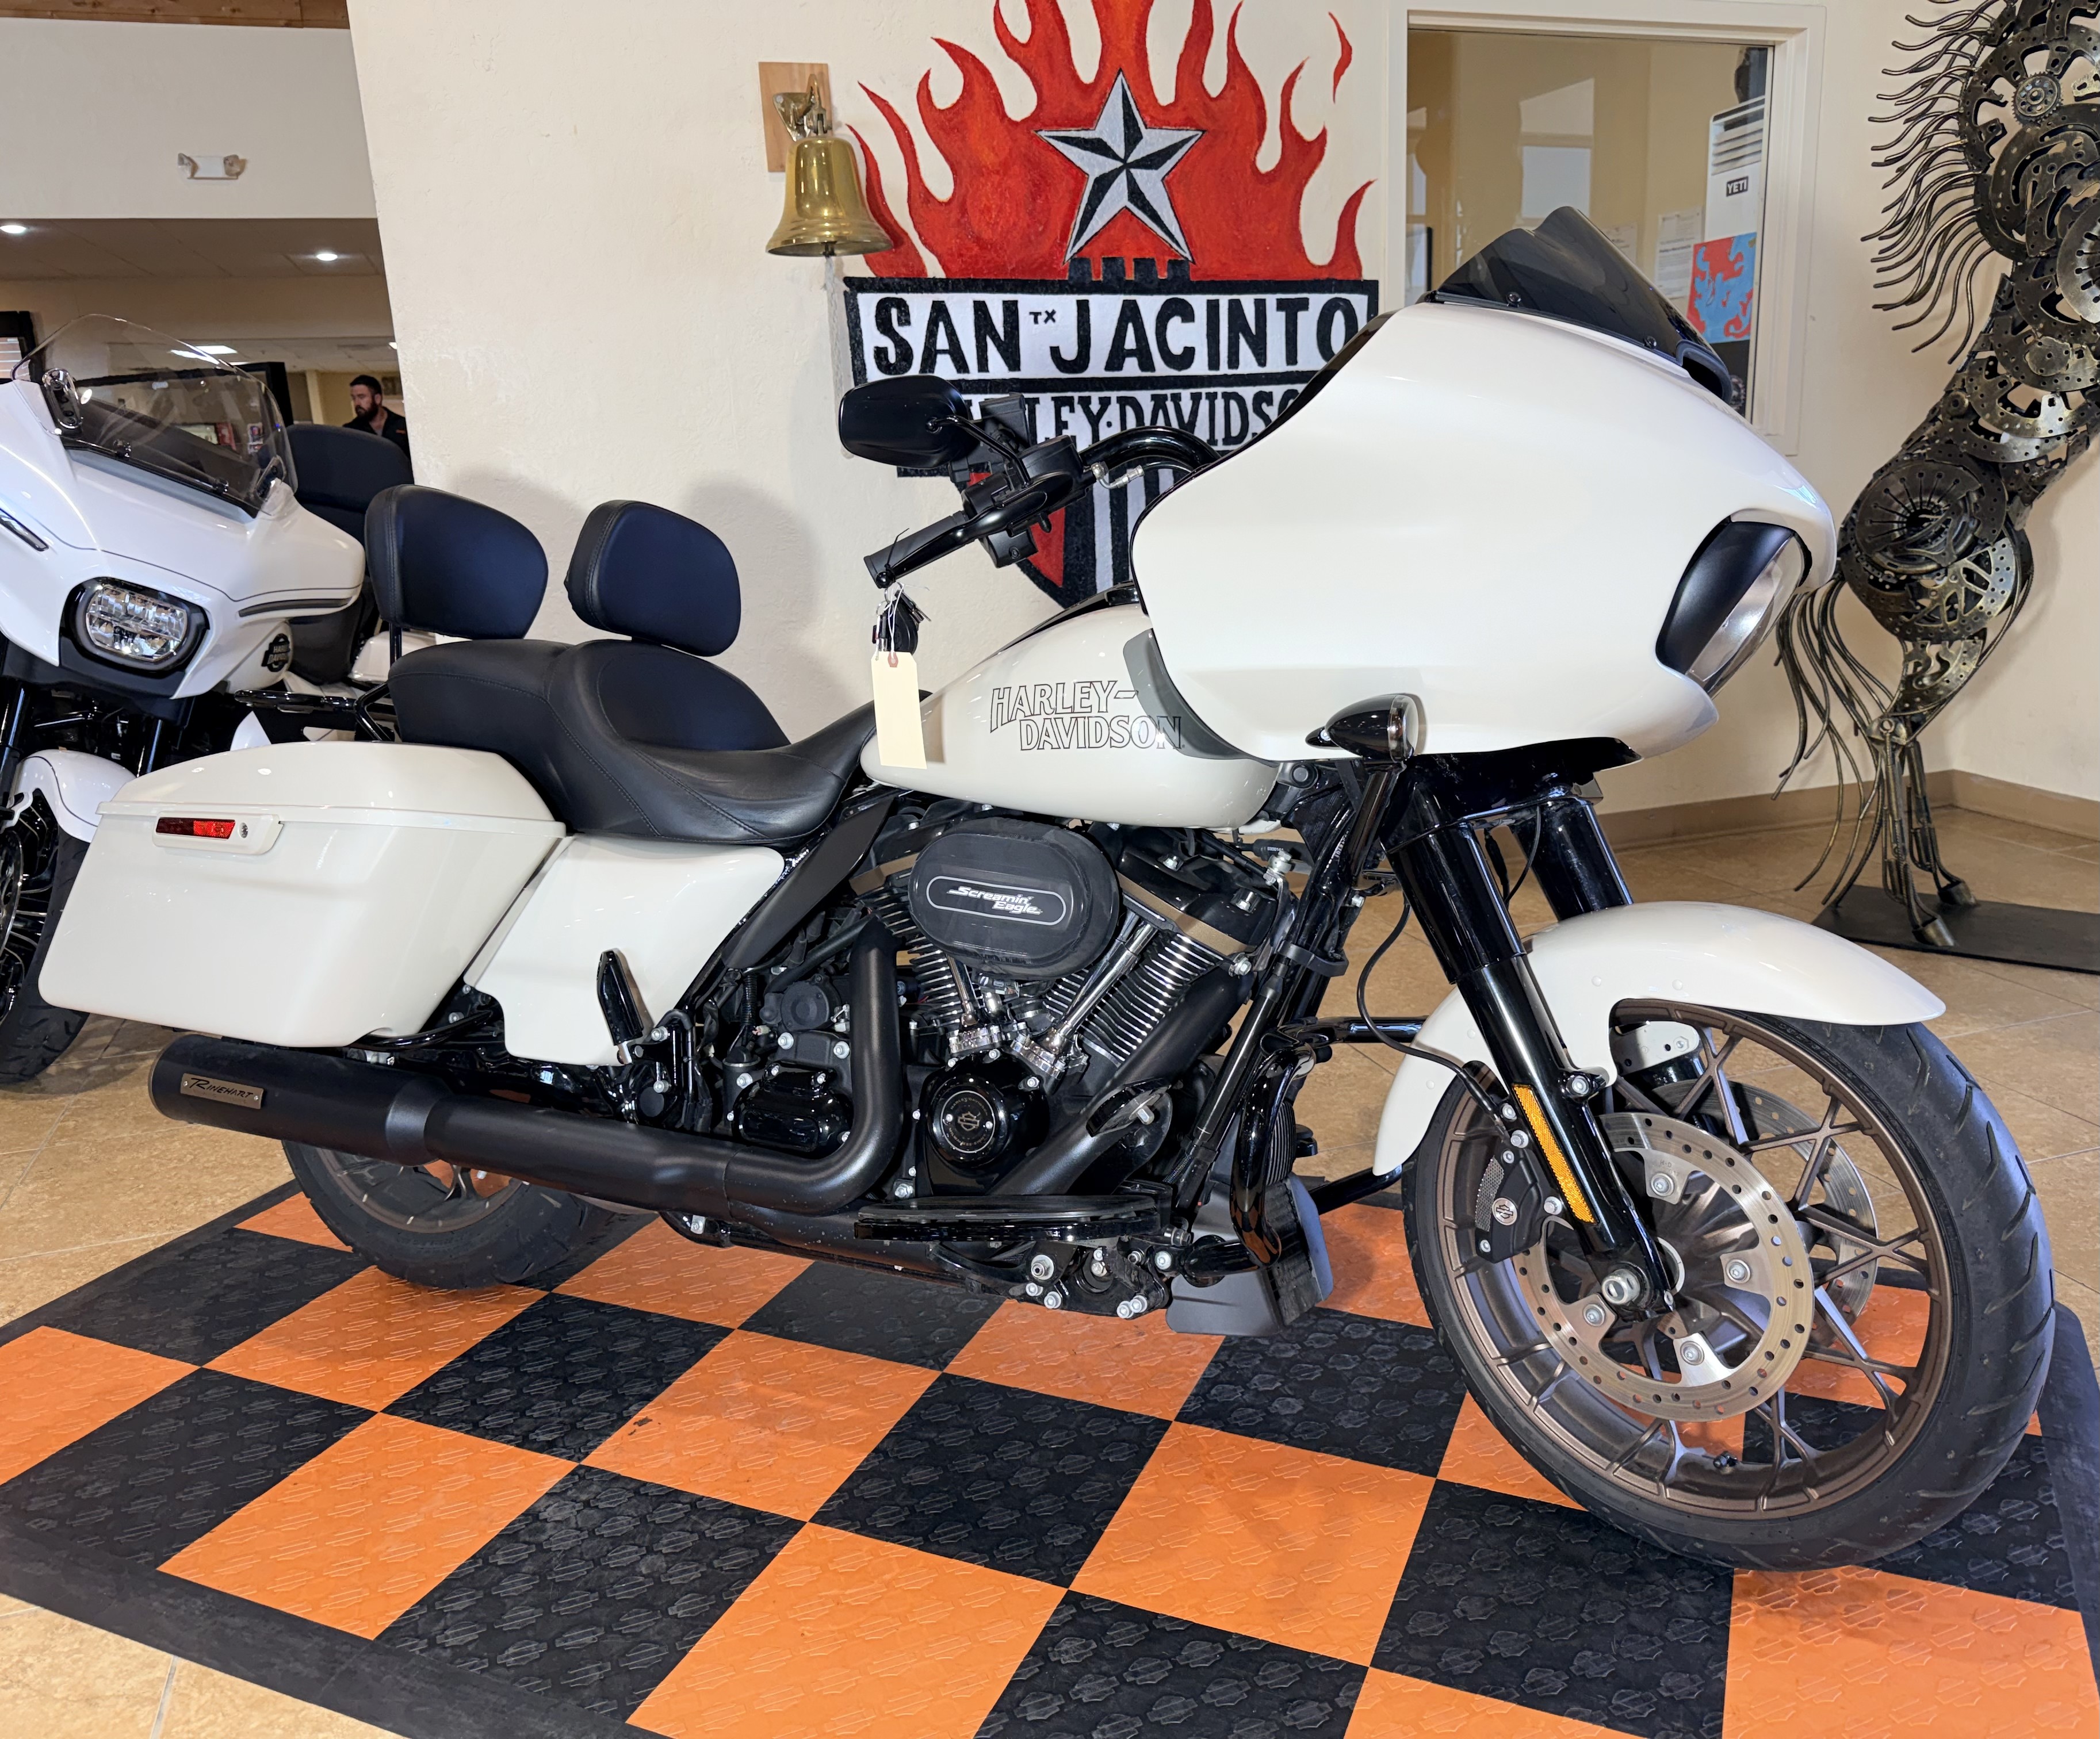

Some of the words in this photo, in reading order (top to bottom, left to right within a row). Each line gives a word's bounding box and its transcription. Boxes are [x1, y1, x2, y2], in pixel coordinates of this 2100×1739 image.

[1727, 179, 1747, 194] YETI
[874, 297, 1021, 375] SAN
[1029, 309, 1056, 324] TX
[1050, 297, 1359, 374] JACINTO
[990, 680, 1138, 733] HARLEY-
[1019, 715, 1182, 750] DAVIDSON
[992, 901, 1043, 915] Eagle
[189, 1078, 253, 1098] RINEHART
